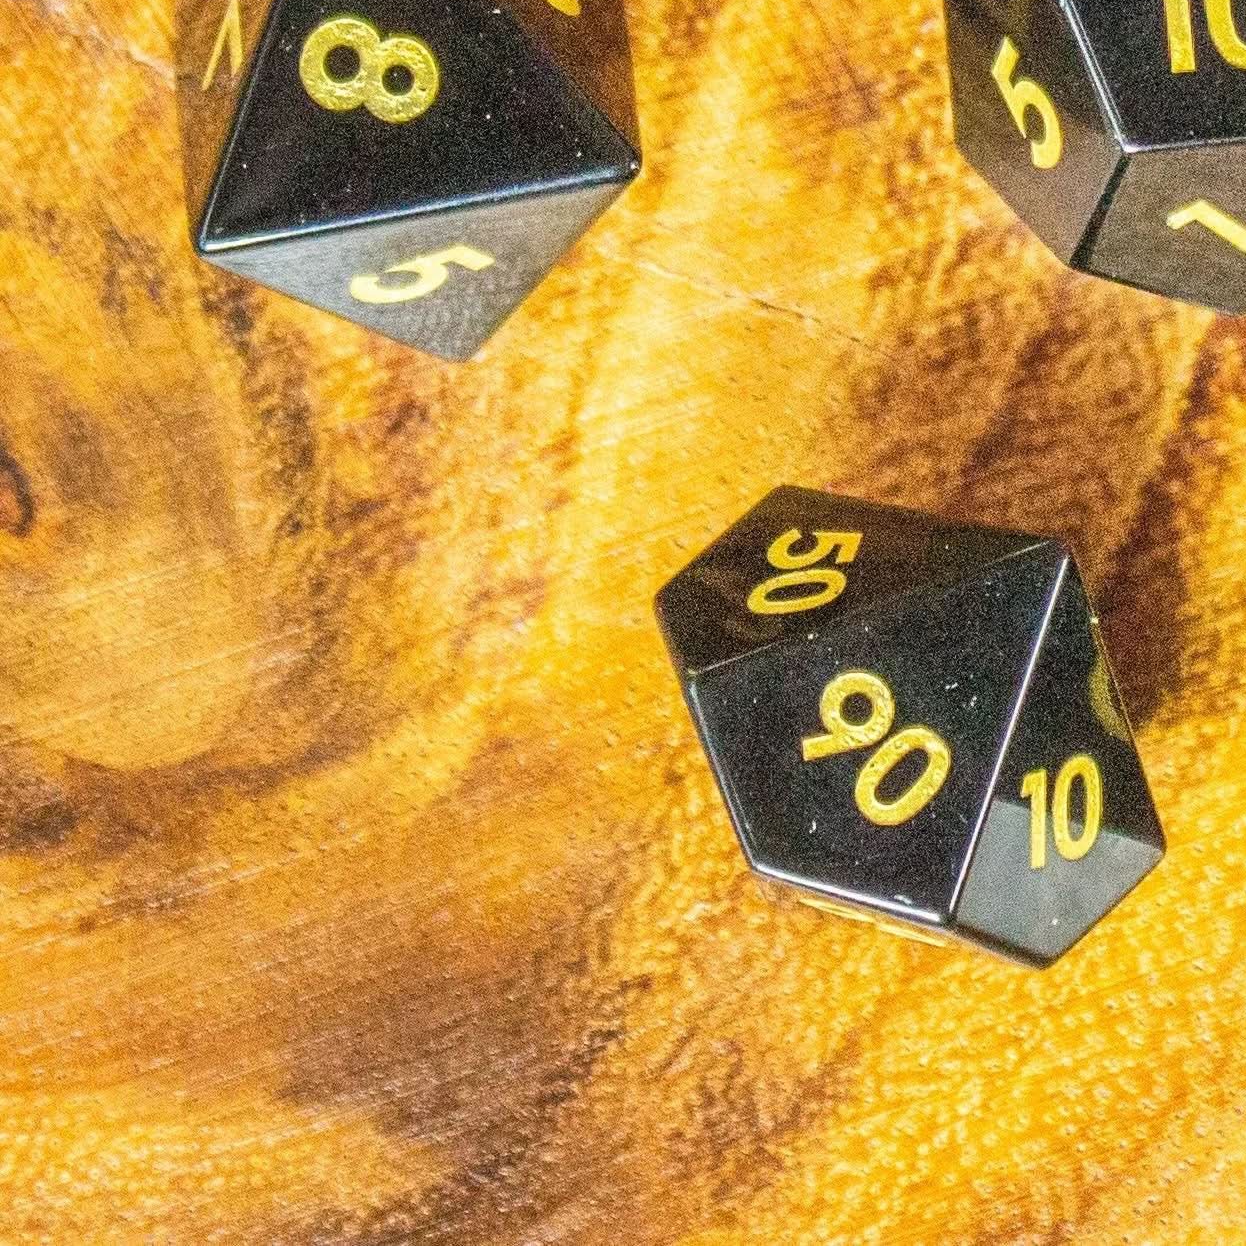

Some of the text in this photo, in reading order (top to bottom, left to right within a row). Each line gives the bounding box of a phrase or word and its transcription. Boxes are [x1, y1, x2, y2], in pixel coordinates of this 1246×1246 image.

[300, 16, 439, 123] 8
[992, 37, 1062, 168] 5
[349, 245, 495, 303] 5
[747, 530, 862, 613] 50
[802, 671, 950, 825] 90
[1020, 754, 1102, 869] 10
